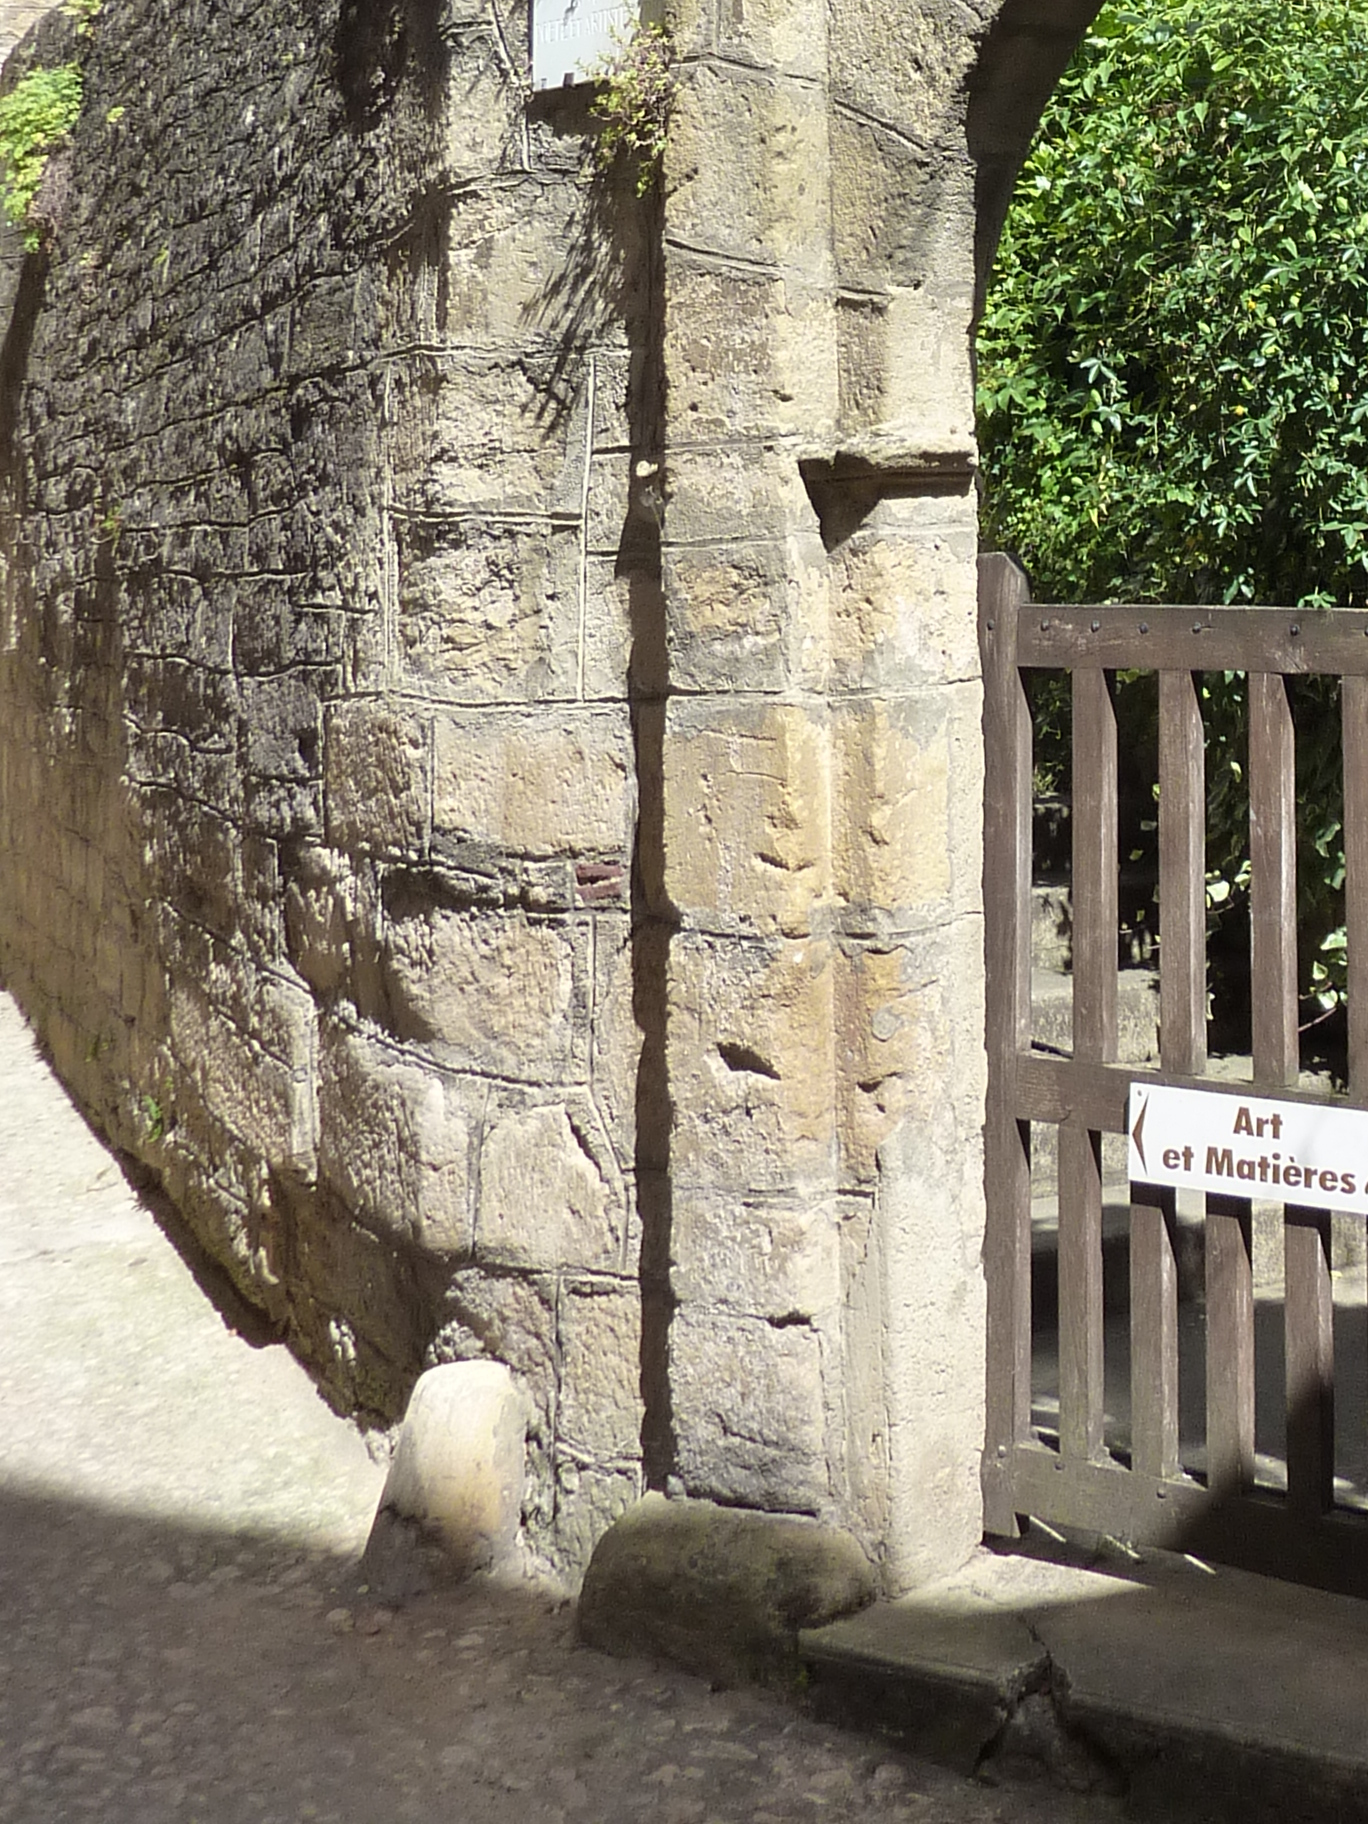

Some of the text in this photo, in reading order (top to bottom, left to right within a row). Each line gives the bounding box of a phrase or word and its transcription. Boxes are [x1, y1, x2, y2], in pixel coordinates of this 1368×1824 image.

[1233, 1106, 1283, 1140] Art
[1162, 1145, 1356, 1194] et Matières
